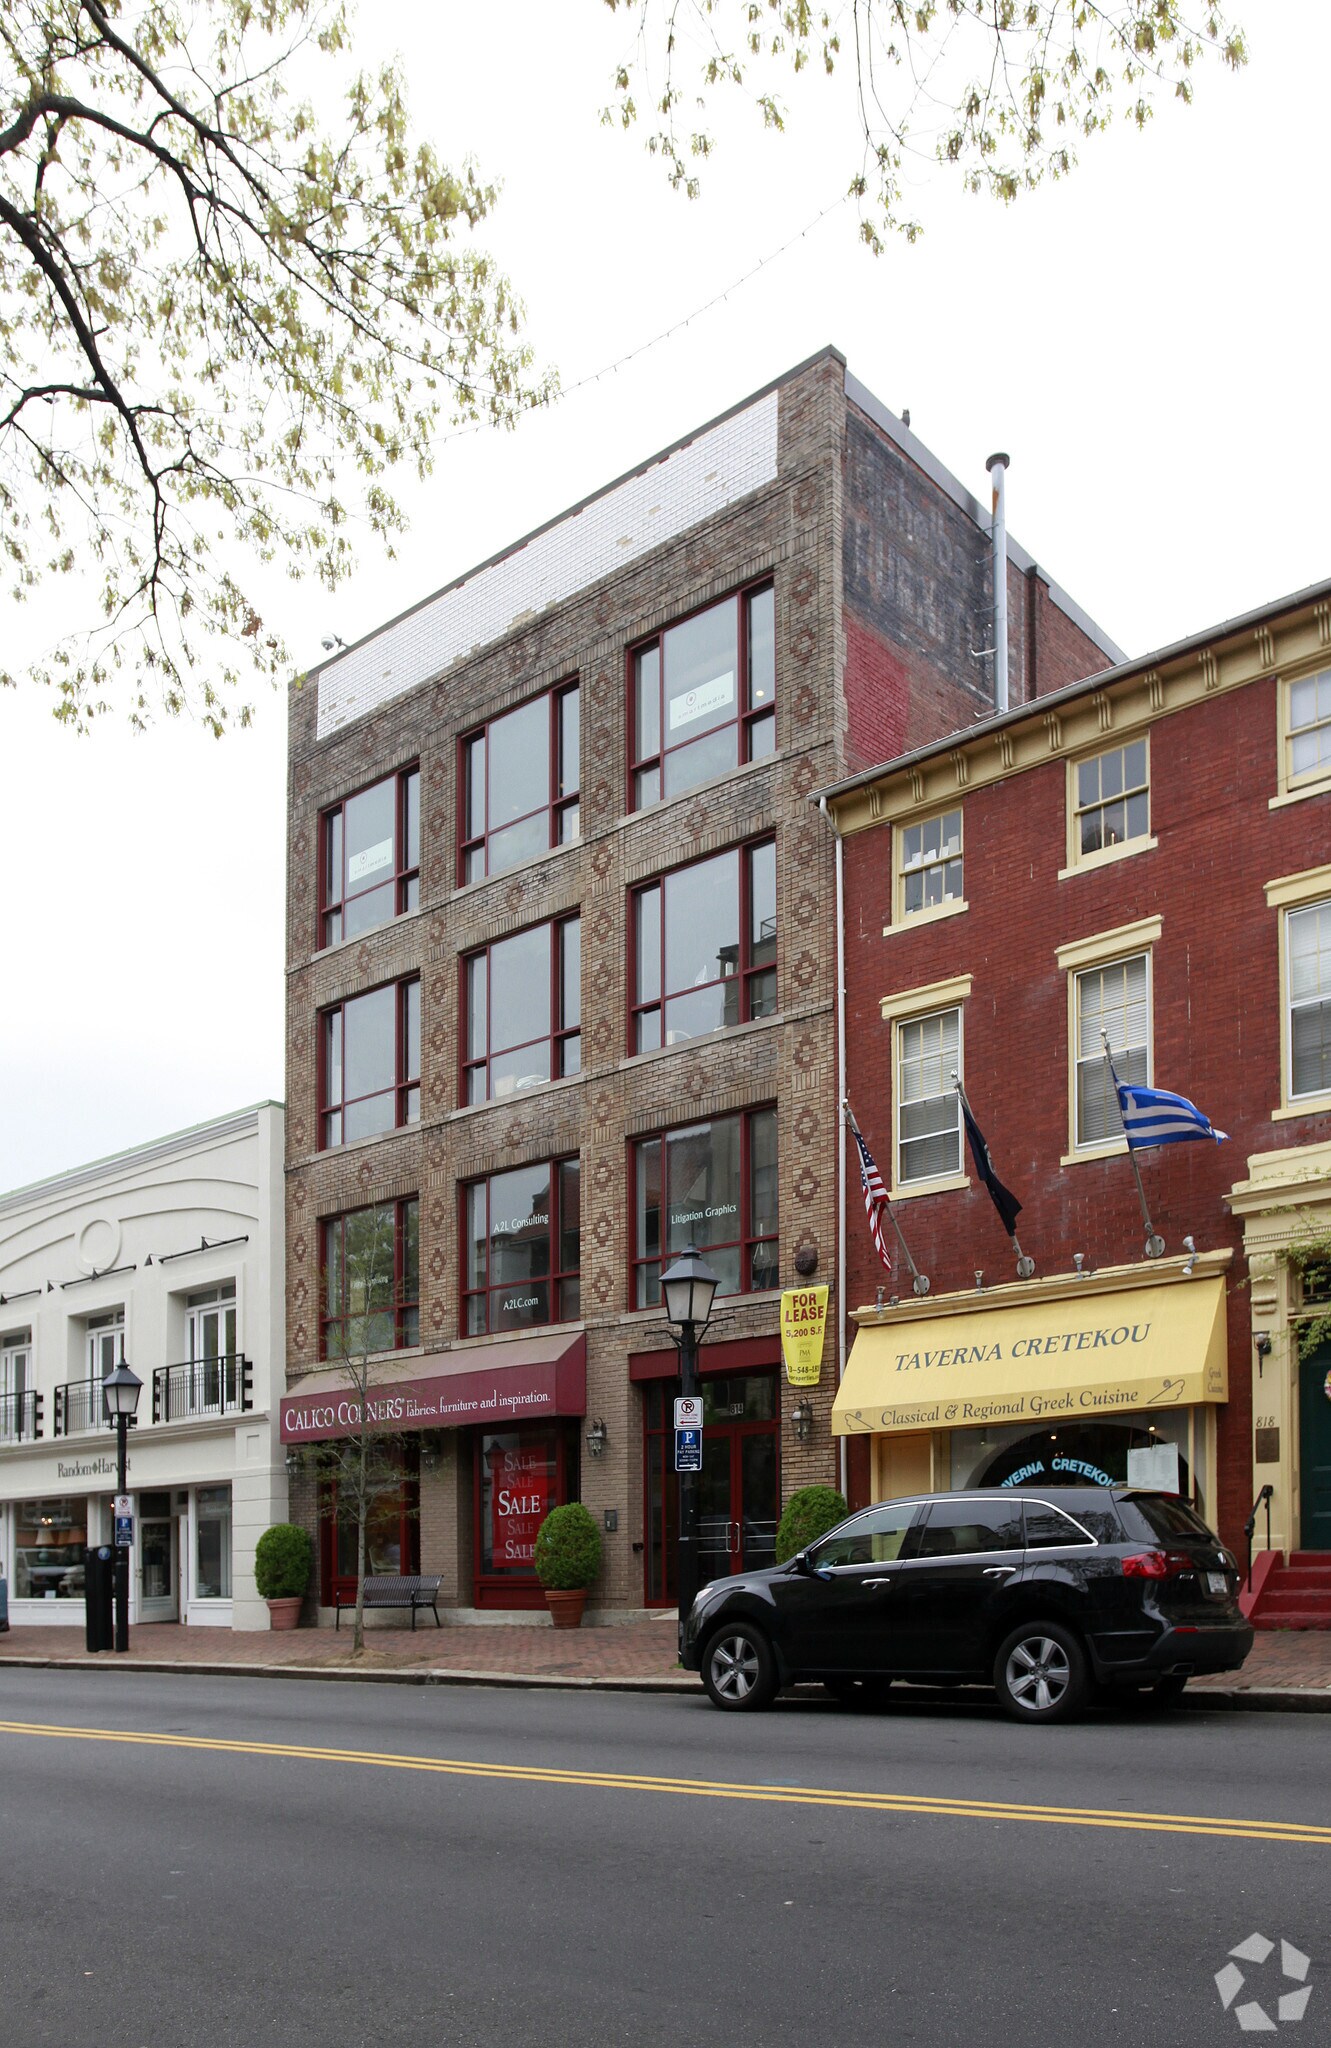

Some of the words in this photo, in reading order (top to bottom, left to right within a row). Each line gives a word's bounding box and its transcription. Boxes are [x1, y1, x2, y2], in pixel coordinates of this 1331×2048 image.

[493, 1221, 510, 1234] A2L
[511, 1214, 549, 1230] Consulting
[671, 1211, 703, 1225] Litigation
[705, 1204, 737, 1218] Graphics
[503, 1297, 539, 1311] A2LC.com
[792, 1292, 817, 1309] FOR
[785, 1306, 824, 1323] LEASE
[785, 1328, 808, 1339] 5,200
[894, 1343, 1003, 1373] TAVERNA
[1011, 1323, 1152, 1359] CRETEKOU
[285, 1406, 335, 1432] CALICO
[439, 1396, 478, 1413] furniture
[480, 1390, 497, 1409] and
[499, 1390, 551, 1413] inspiration.
[730, 1403, 743, 1415] 814
[881, 1405, 940, 1426] Classical
[944, 1403, 958, 1420] &
[962, 1397, 1025, 1421] Regional
[1029, 1392, 1074, 1416] Greek
[1079, 1388, 1138, 1407] Cuisine
[1256, 1416, 1275, 1428] 818
[685, 1431, 693, 1443] P
[57, 1461, 92, 1478] Random
[98, 1457, 131, 1474] Harvst
[504, 1452, 537, 1472] SALE
[498, 1490, 541, 1516] SALE
